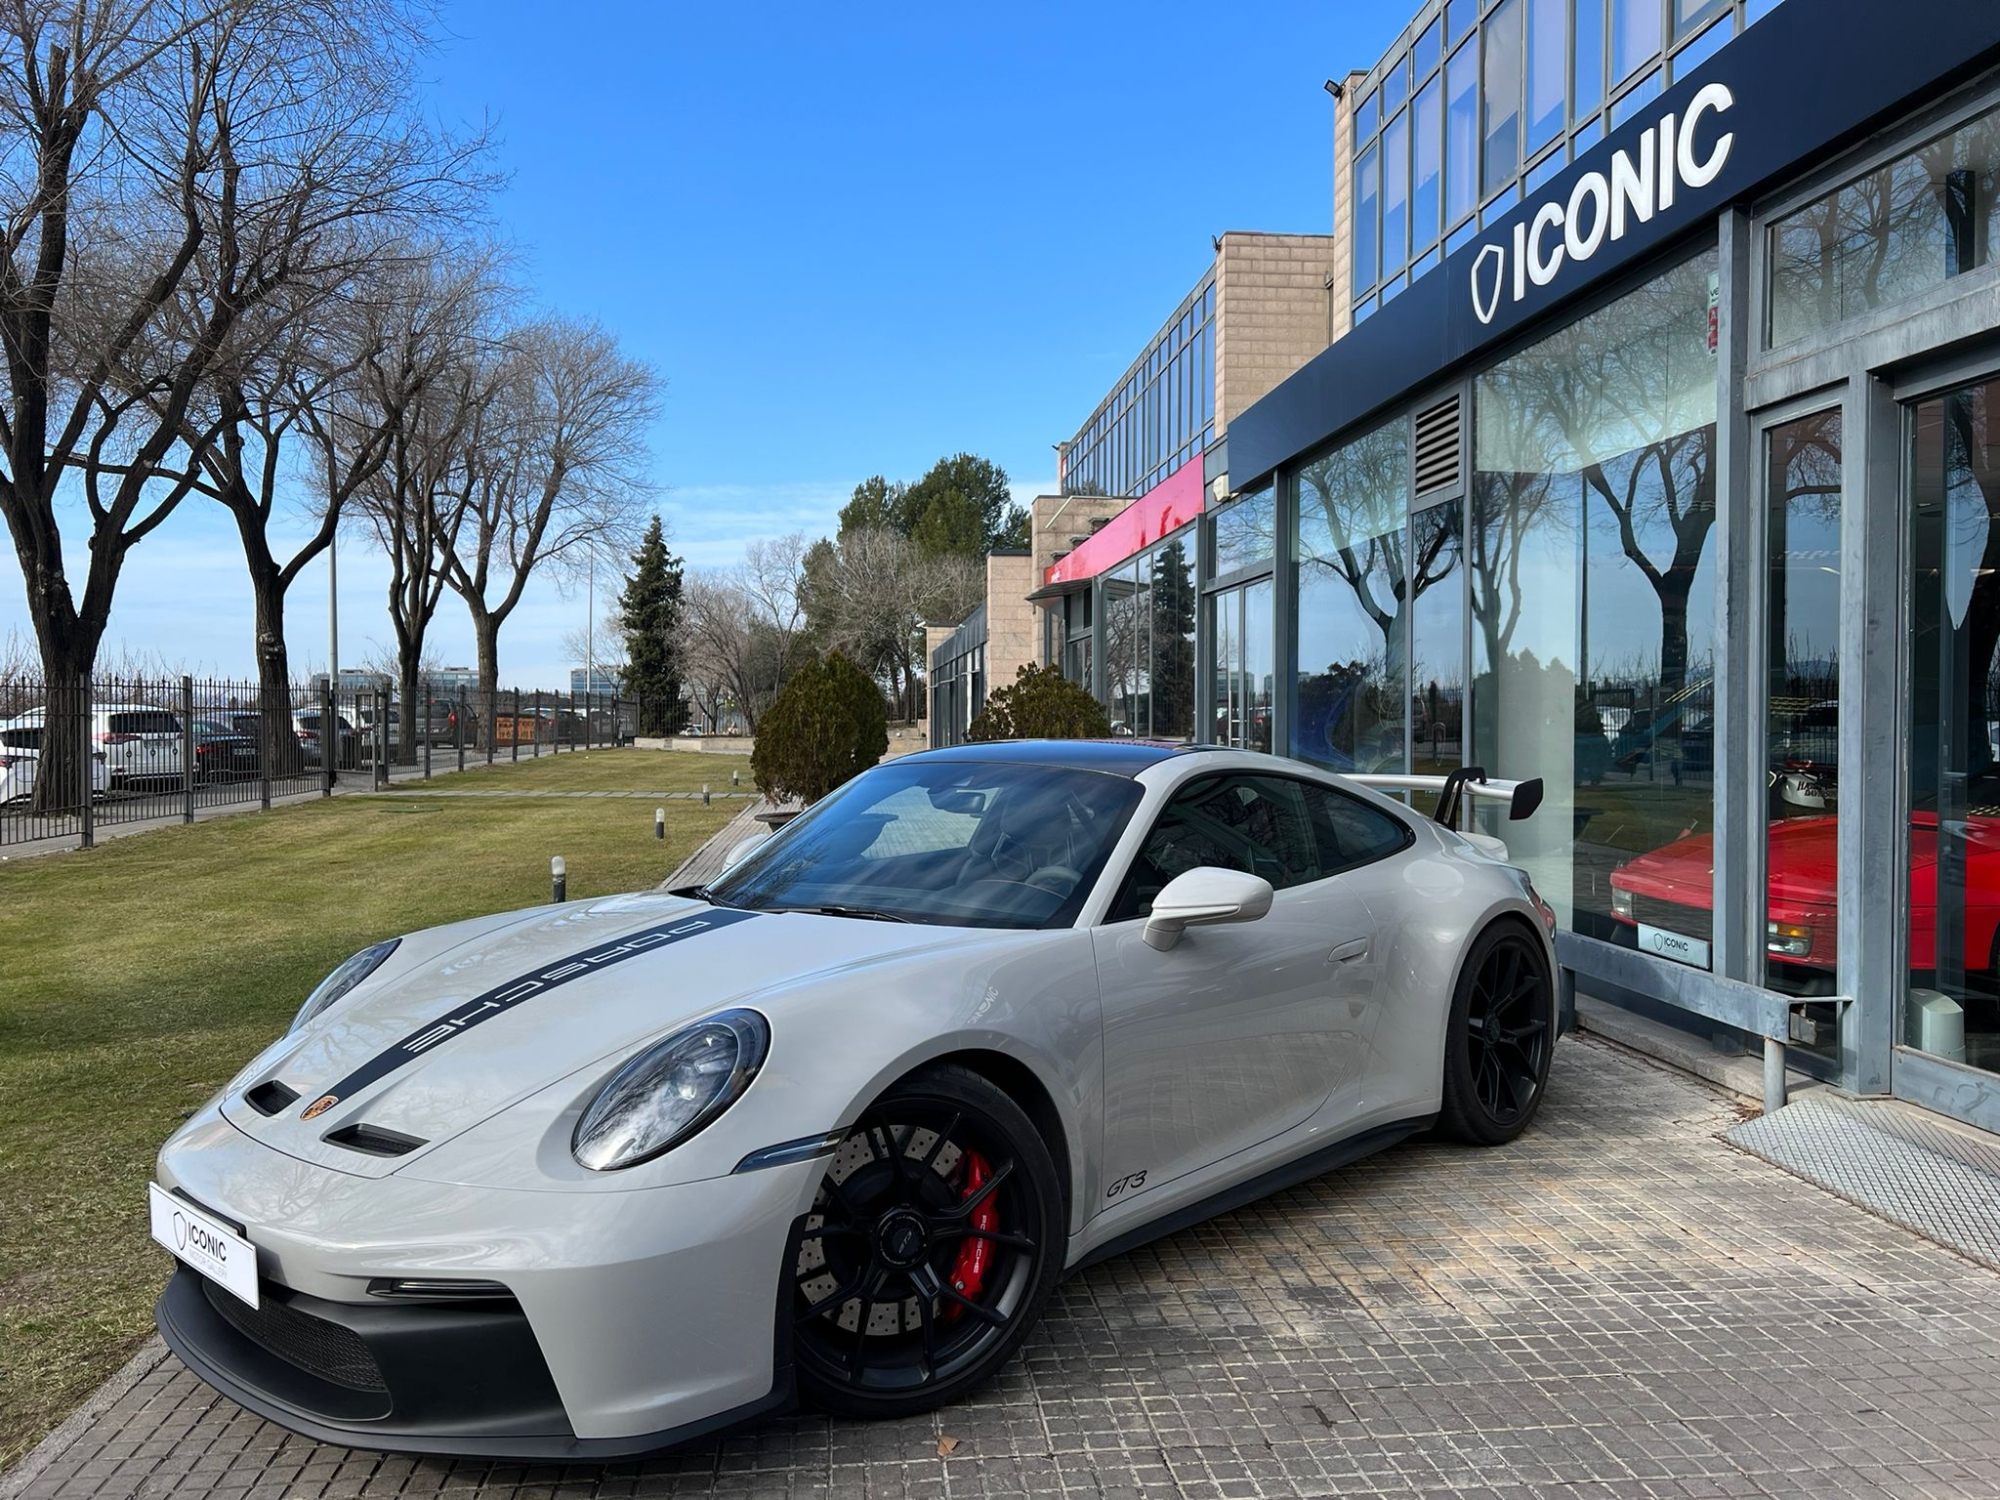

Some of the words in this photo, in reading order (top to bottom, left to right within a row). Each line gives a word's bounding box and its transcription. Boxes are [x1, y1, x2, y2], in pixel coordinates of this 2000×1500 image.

[1513, 82, 1735, 302] ICONIC
[1664, 936, 1689, 951] ICONIC
[402, 920, 712, 1053] PORSCHE
[1107, 1169, 1148, 1198] GT3
[188, 1222, 227, 1262] ICONIC
